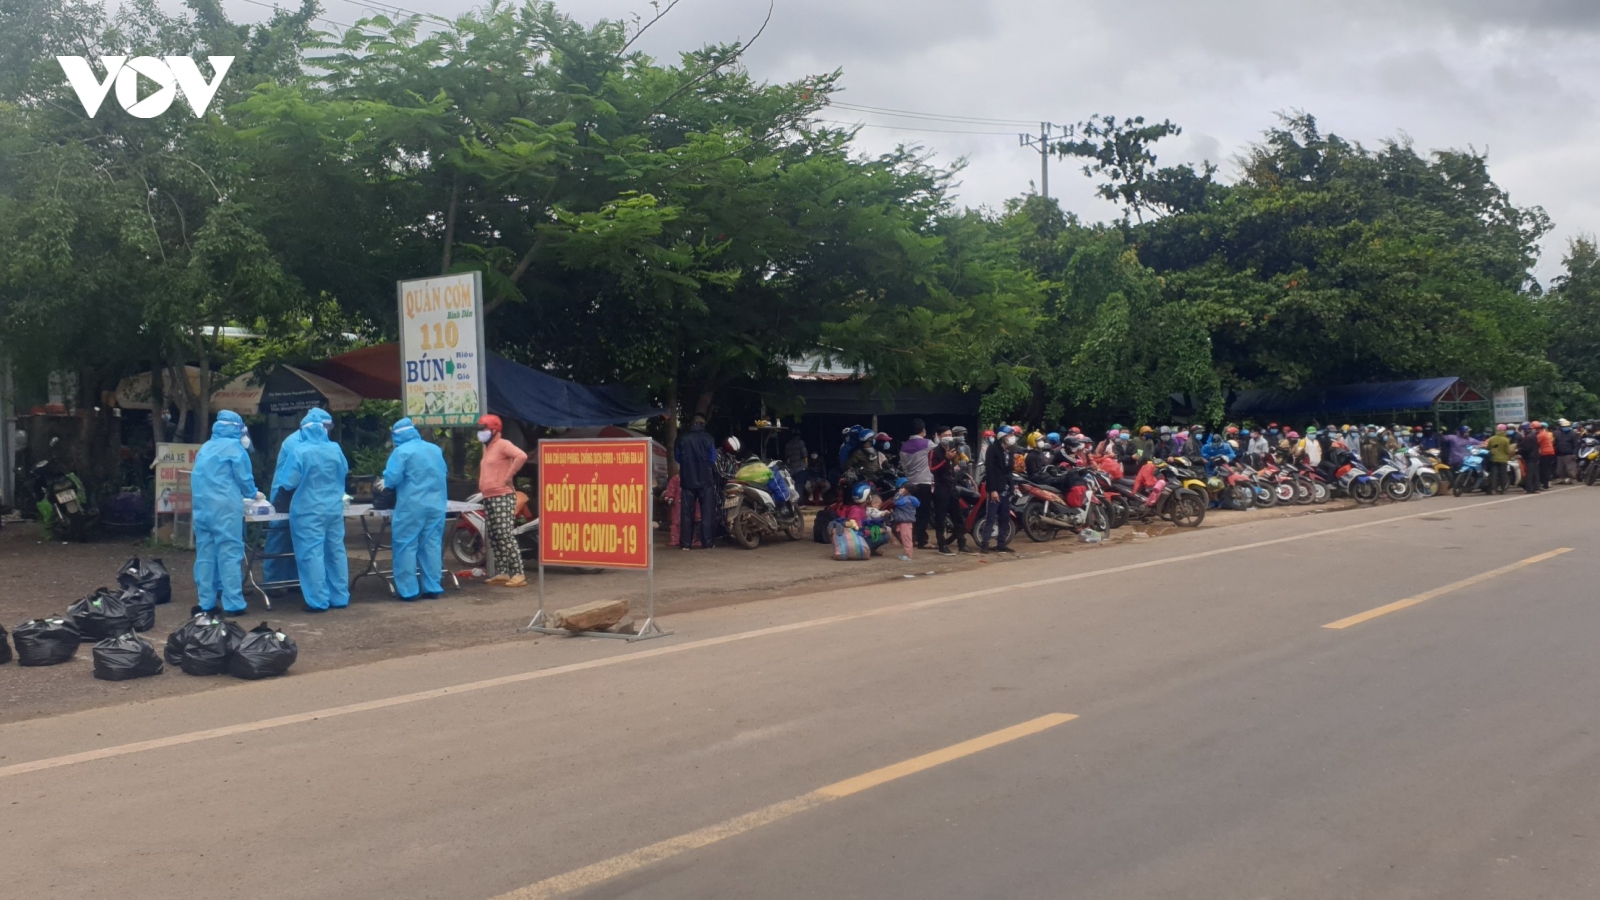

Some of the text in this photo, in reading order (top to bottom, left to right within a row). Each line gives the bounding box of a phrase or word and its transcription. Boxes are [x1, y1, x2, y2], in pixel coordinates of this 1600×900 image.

[406, 280, 472, 319] QUÁN CƠM
[421, 320, 459, 350] 110
[406, 352, 445, 383] BÚN
[177, 453, 185, 462] XE
[546, 472, 643, 513] CHỐT KIỂM SOÁT
[552, 522, 636, 557] DỊCH COVID-19
